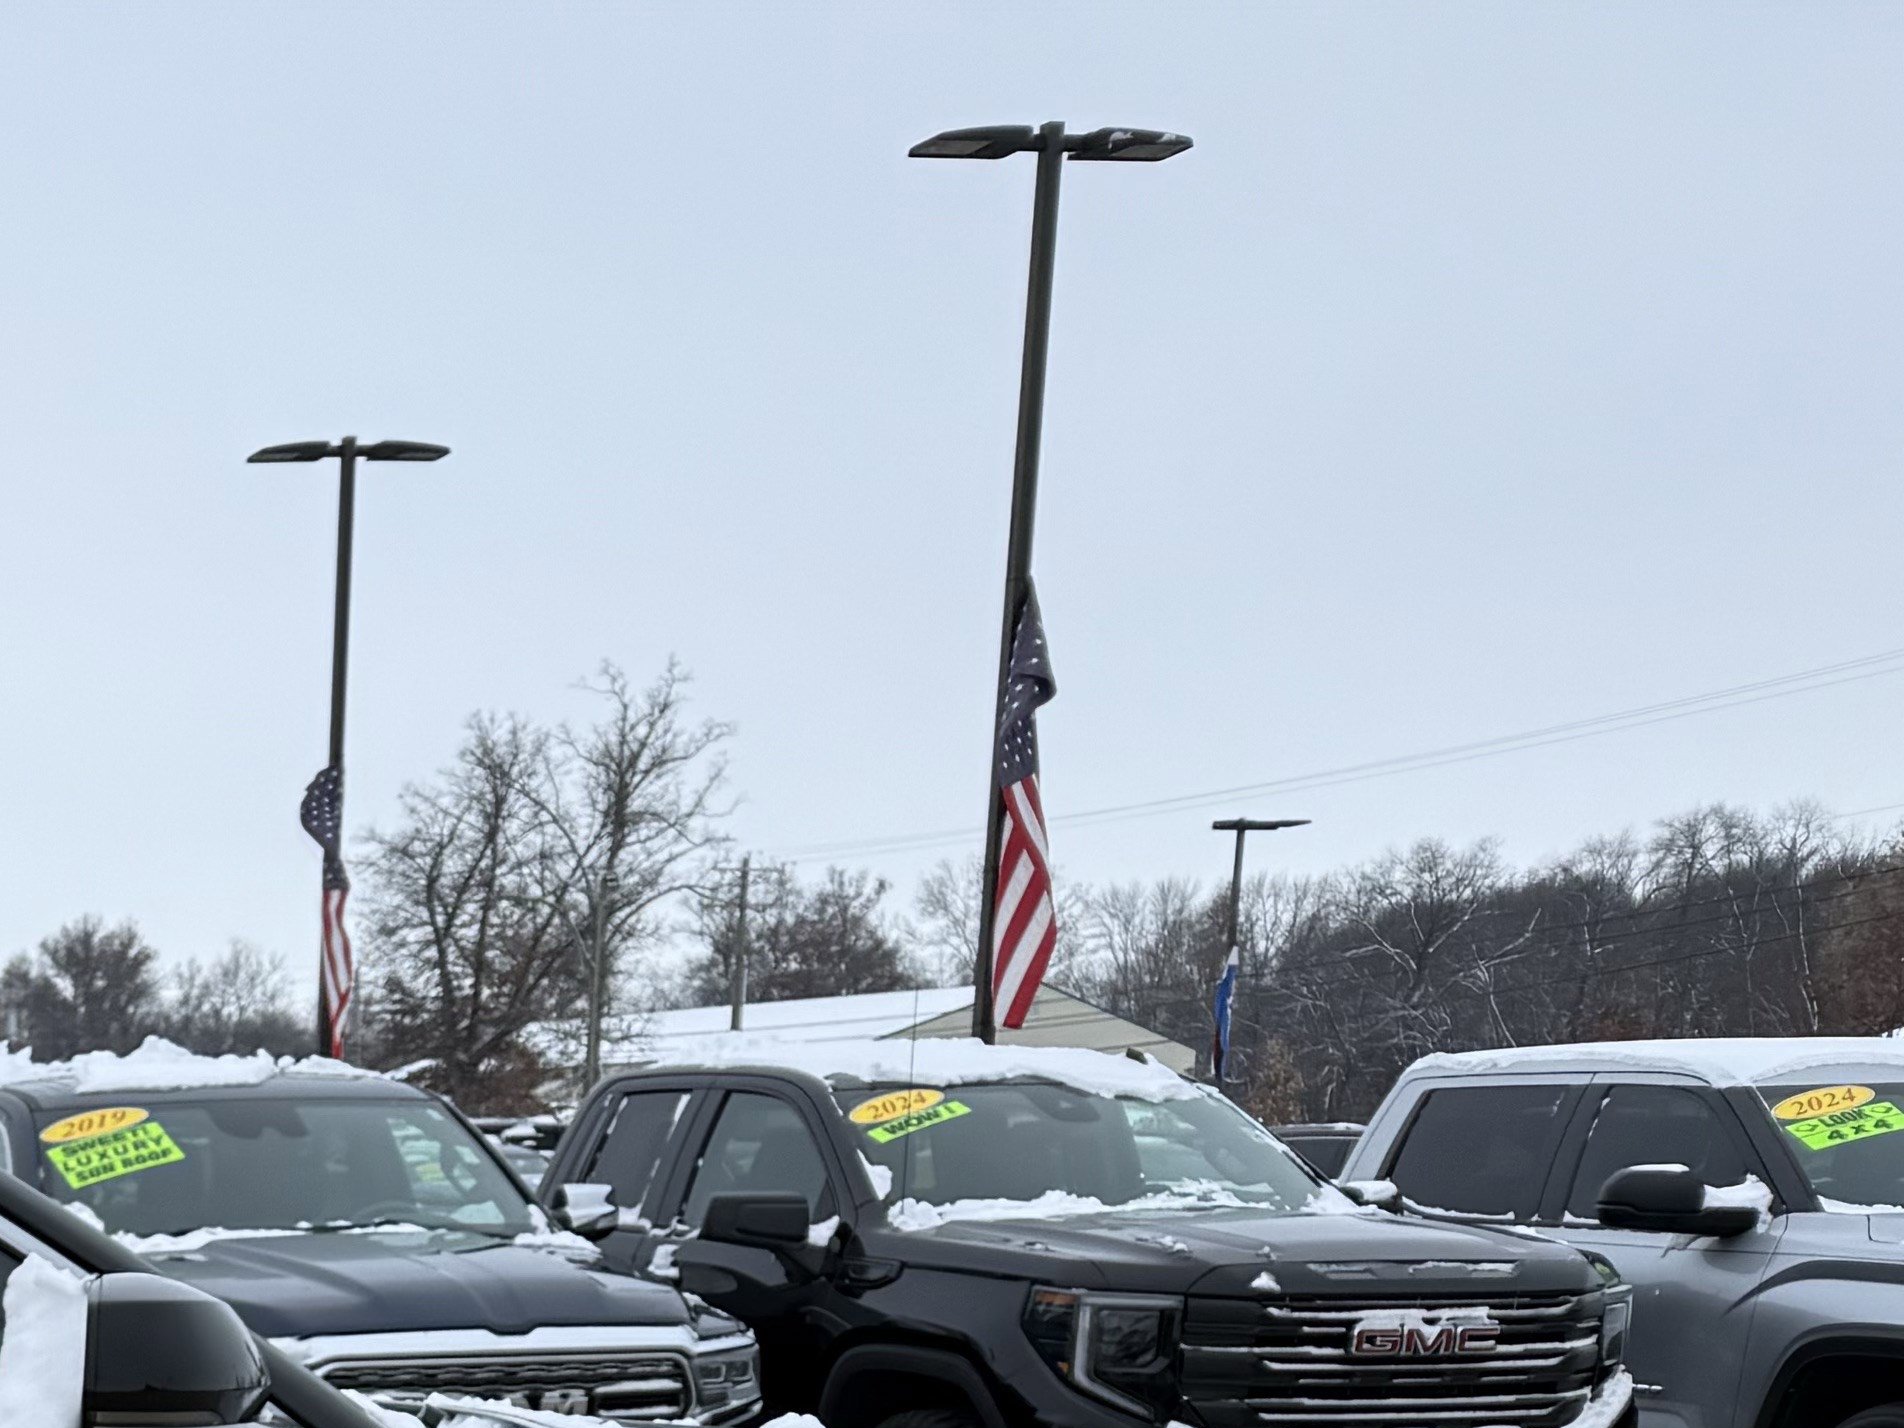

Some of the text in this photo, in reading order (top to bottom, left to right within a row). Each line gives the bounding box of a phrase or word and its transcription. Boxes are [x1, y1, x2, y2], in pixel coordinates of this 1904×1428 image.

[868, 1091, 927, 1120] 2024
[1790, 1088, 1856, 1116] 2024
[62, 1110, 127, 1139] 2019
[1817, 1107, 1874, 1128] LOOK
[63, 1134, 165, 1172] LUXURY
[75, 1148, 173, 1182] SUN ROOF
[1354, 1325, 1500, 1355] GMC
